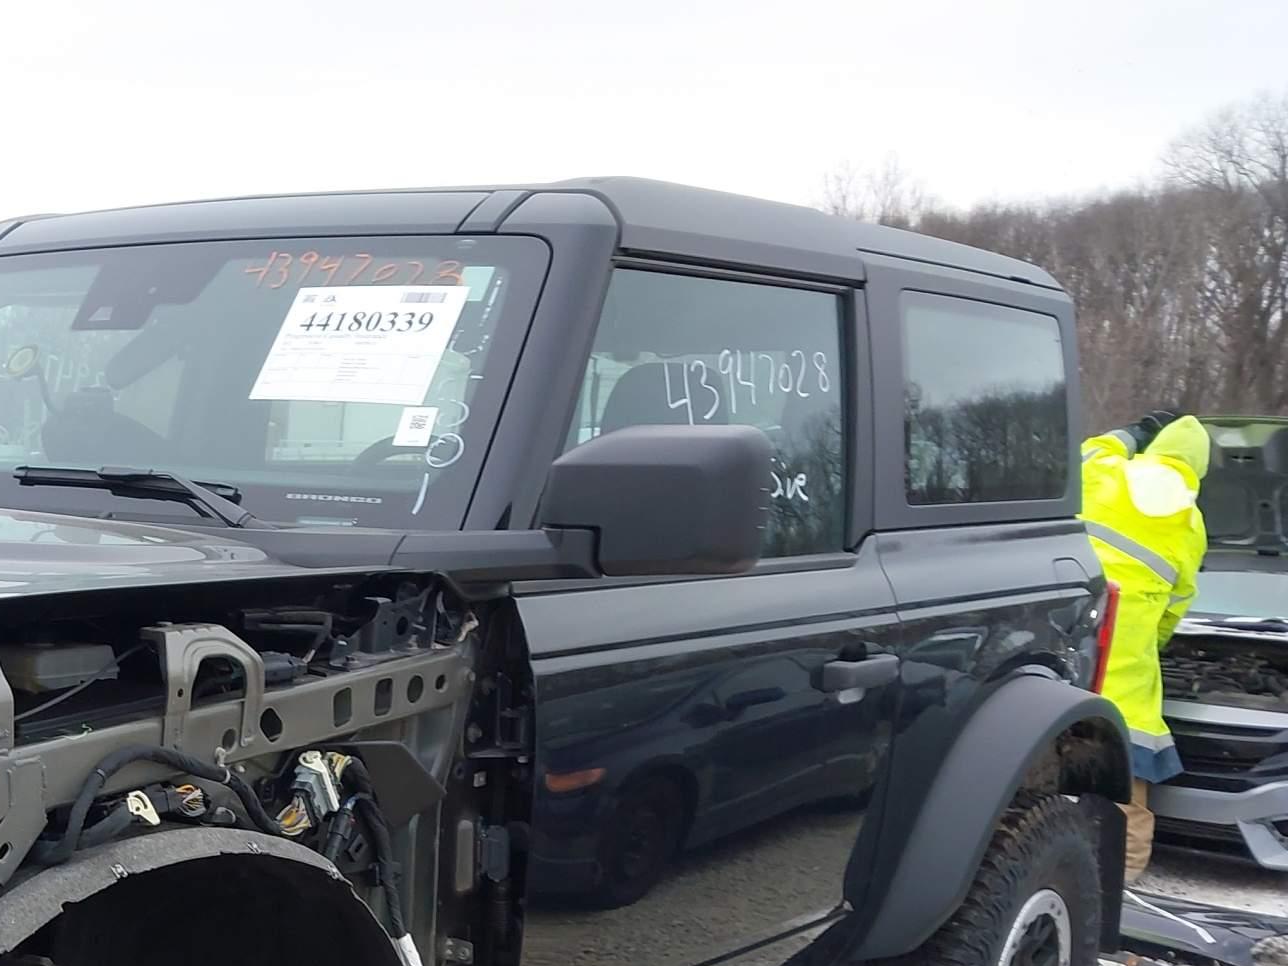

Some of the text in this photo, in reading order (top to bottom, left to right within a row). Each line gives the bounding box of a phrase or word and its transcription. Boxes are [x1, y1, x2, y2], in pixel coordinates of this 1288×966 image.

[299, 312, 434, 332] 44180339
[664, 349, 831, 425] 43947028
[286, 493, 383, 505] BRONCO
